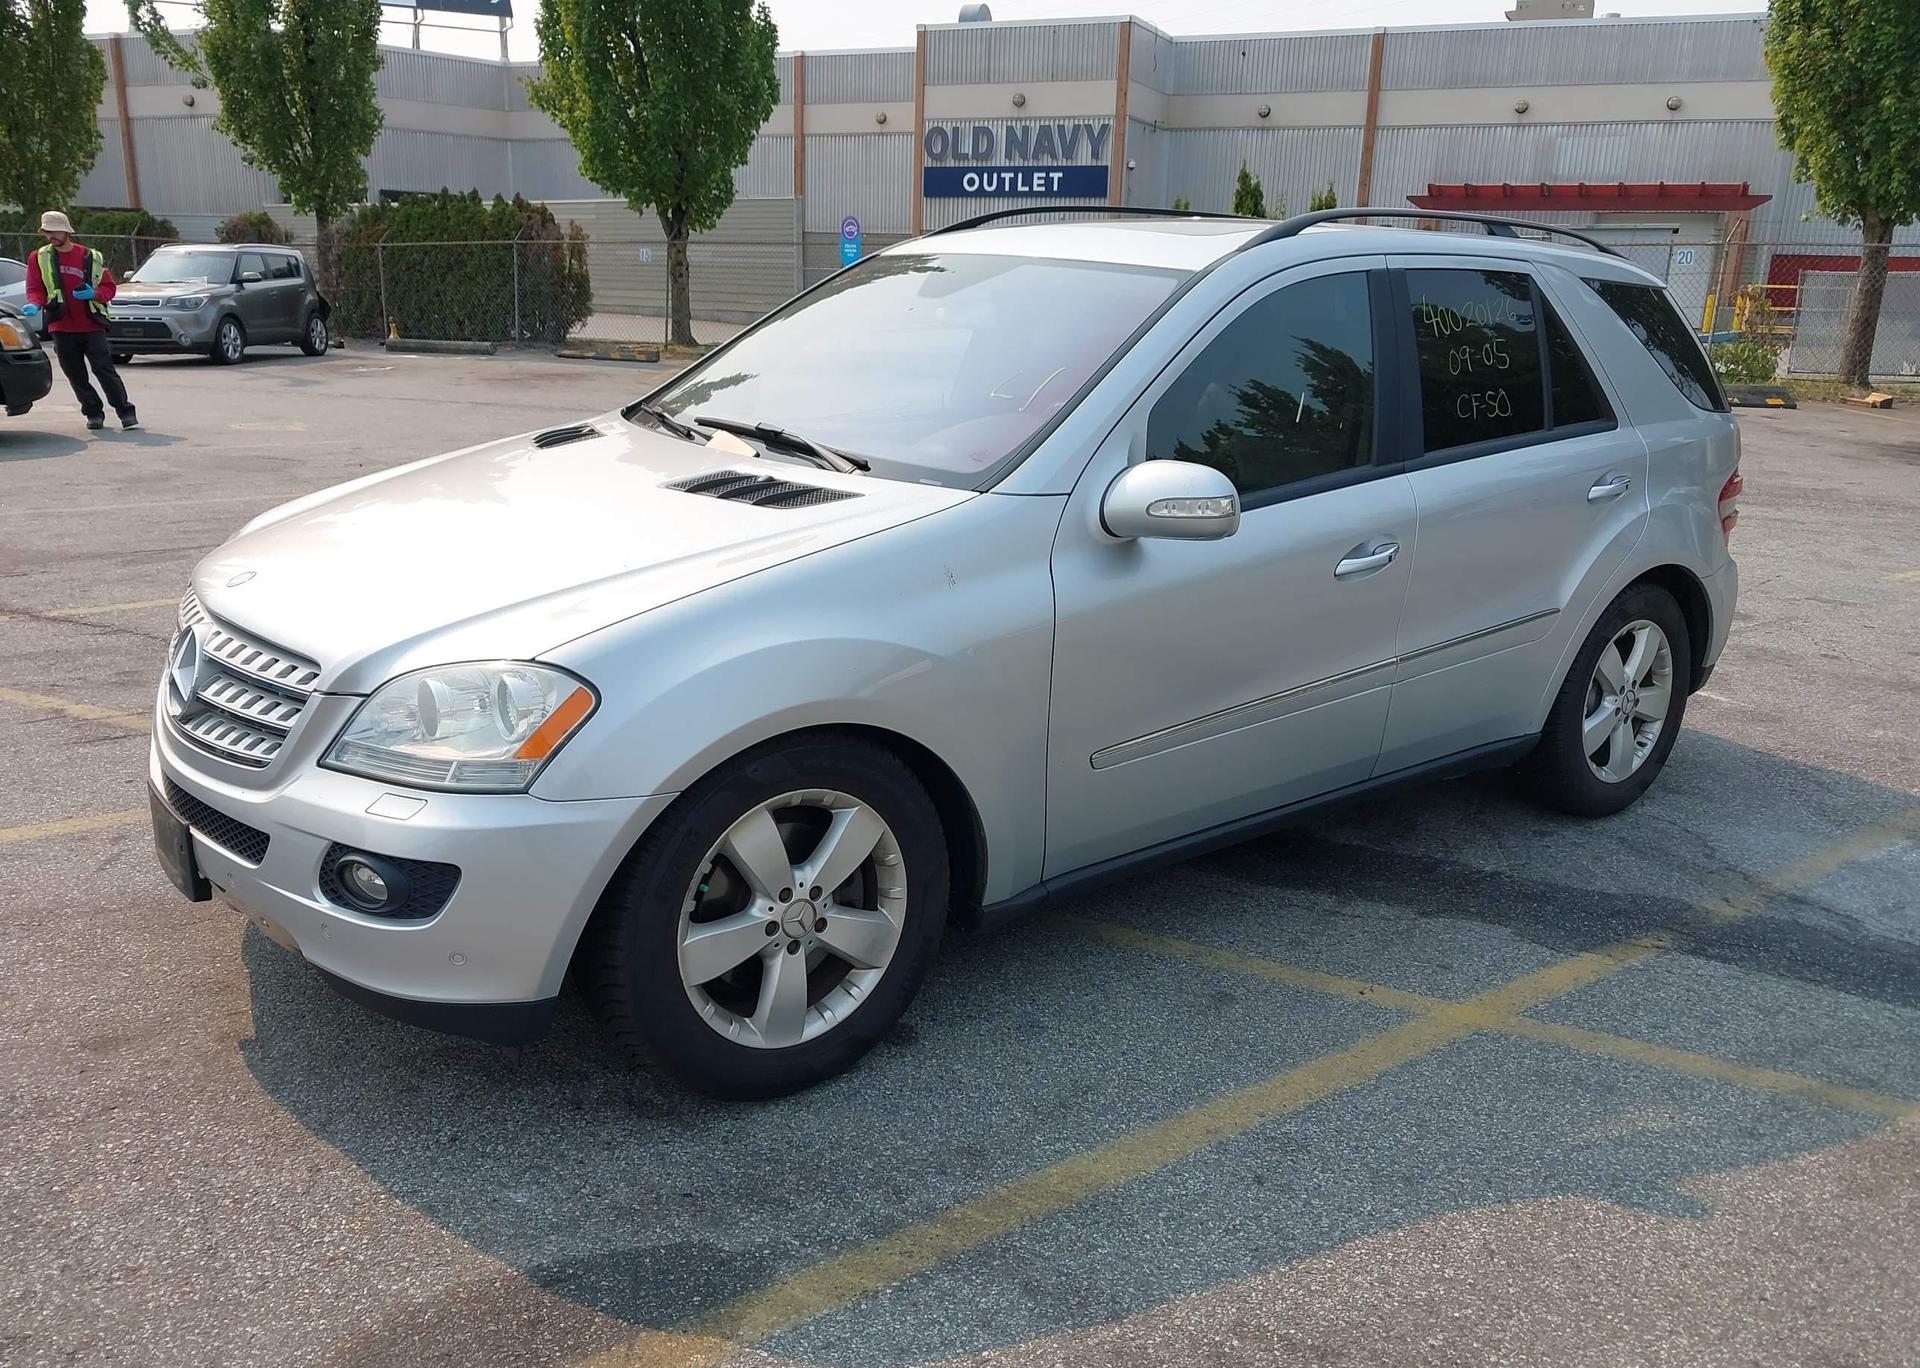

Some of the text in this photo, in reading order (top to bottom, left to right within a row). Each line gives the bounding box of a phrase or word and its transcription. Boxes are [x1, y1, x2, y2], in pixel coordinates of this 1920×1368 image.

[925, 123, 1110, 161] OLD NAVY
[962, 172, 1063, 192] OUTLET
[1677, 250, 1693, 265] 20
